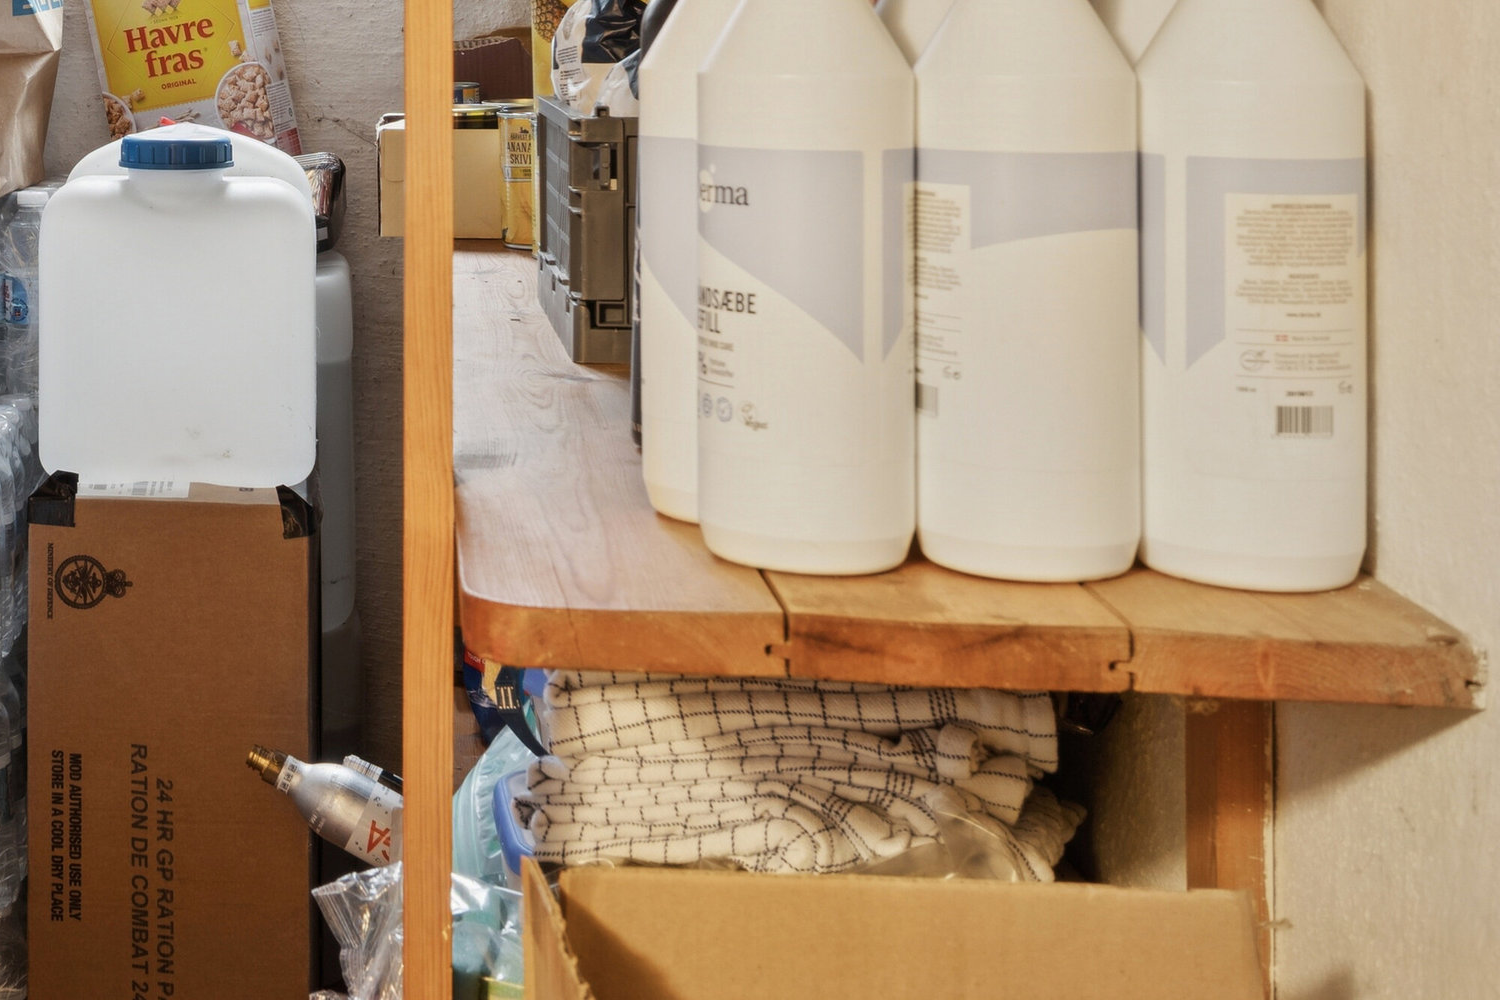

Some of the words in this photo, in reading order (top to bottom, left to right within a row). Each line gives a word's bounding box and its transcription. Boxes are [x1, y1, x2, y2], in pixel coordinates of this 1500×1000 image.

[123, 17, 215, 54] Havre
[145, 49, 205, 79] fras
[161, 78, 197, 90] ORIGINAL
[47, 577, 54, 587] OF
[51, 749, 64, 789] STORE
[69, 753, 82, 782] MOD
[51, 793, 64, 805] IN
[130, 743, 148, 830] RATION
[156, 778, 174, 803] 24
[51, 807, 64, 817] A
[69, 784, 82, 860] AUTHORISED
[156, 809, 174, 842] HR
[51, 819, 64, 852] COOL
[131, 836, 148, 868] DE
[51, 855, 64, 881] DRY
[69, 862, 82, 887] USE
[156, 848, 175, 882] GP
[51, 883, 64, 922] PLACE
[69, 889, 82, 922] ONLY
[131, 874, 149, 975] COMBAT
[156, 887, 175, 975] RATION
